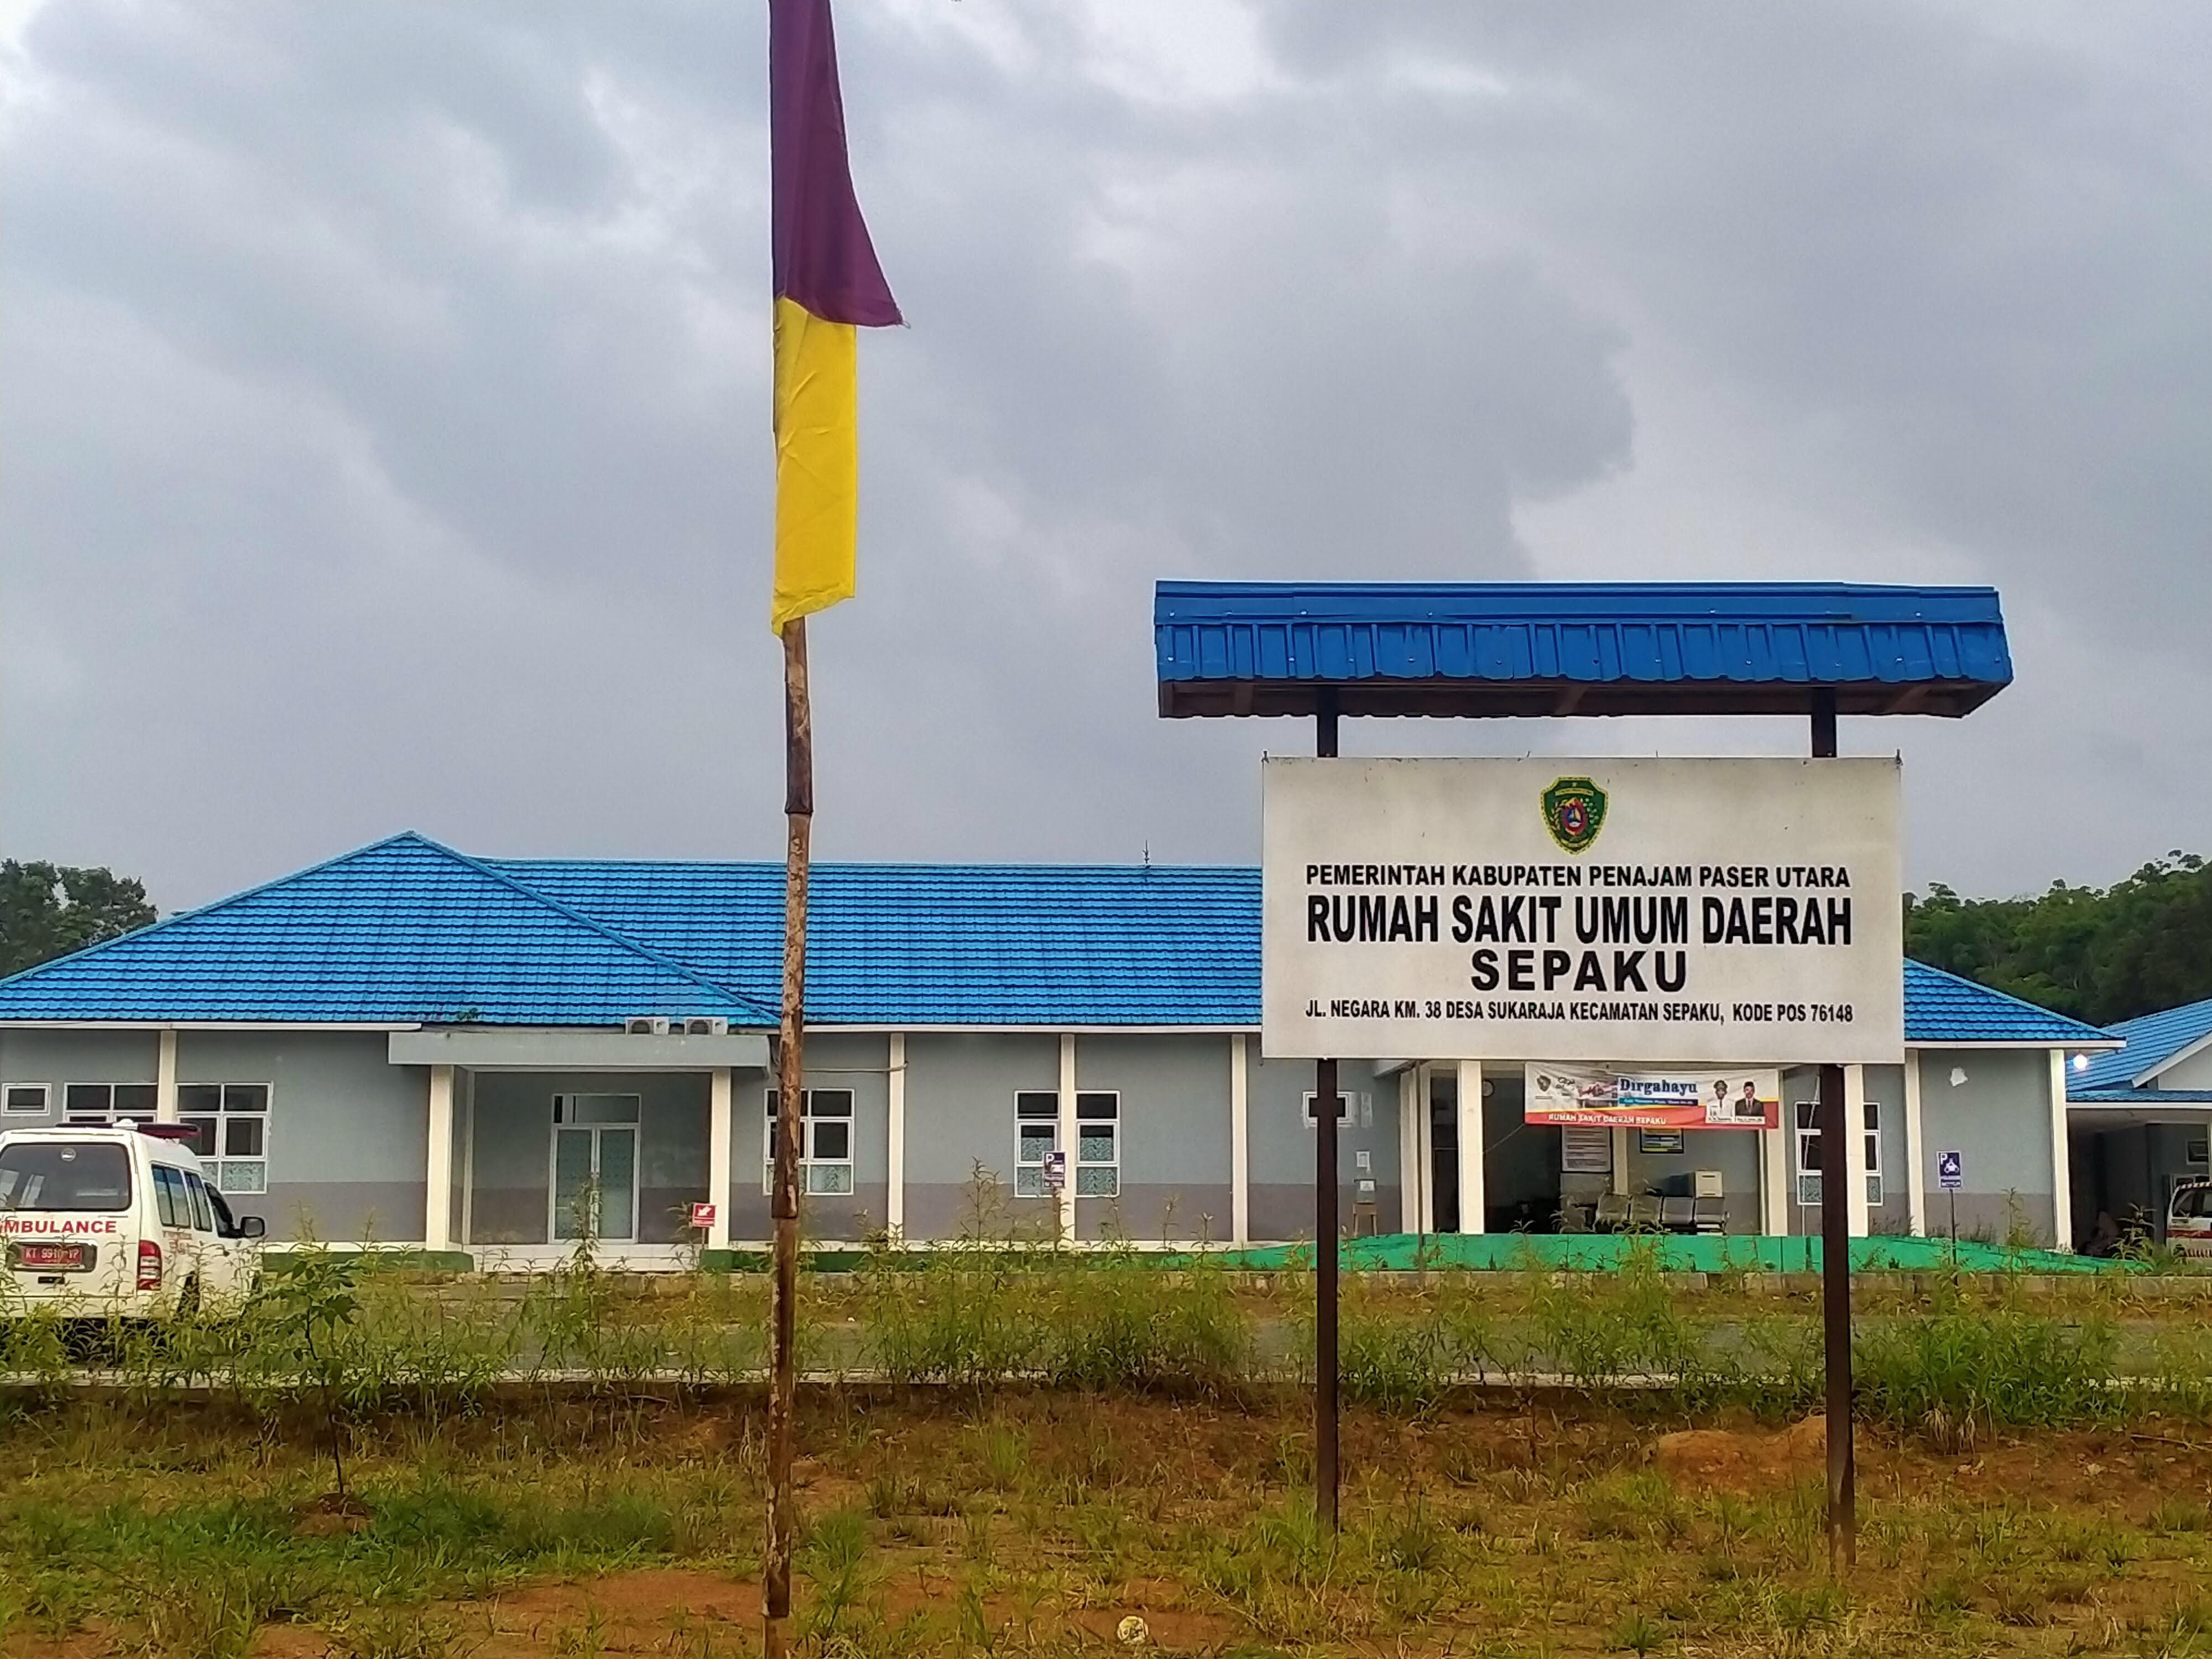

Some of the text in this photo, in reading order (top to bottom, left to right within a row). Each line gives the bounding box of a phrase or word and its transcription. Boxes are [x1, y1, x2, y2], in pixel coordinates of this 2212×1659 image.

[1306, 864, 1851, 888] PEMERINTAH KABUPATEN PENAJAM PASER UTARA
[1307, 895, 1851, 945] RUMAH SAKIT UMUM DAERAH
[1470, 948, 1687, 993] SEPAKU
[1306, 1000, 1854, 1025] JL. NEGARA KM. 38 DESA SUKARAJA KECAMATAN SEPAKU, KODE POS 76148
[1620, 1078, 1698, 1096] Dirgahayu
[1940, 1153, 1948, 1165] P
[0, 1220, 117, 1234] MBULANCE
